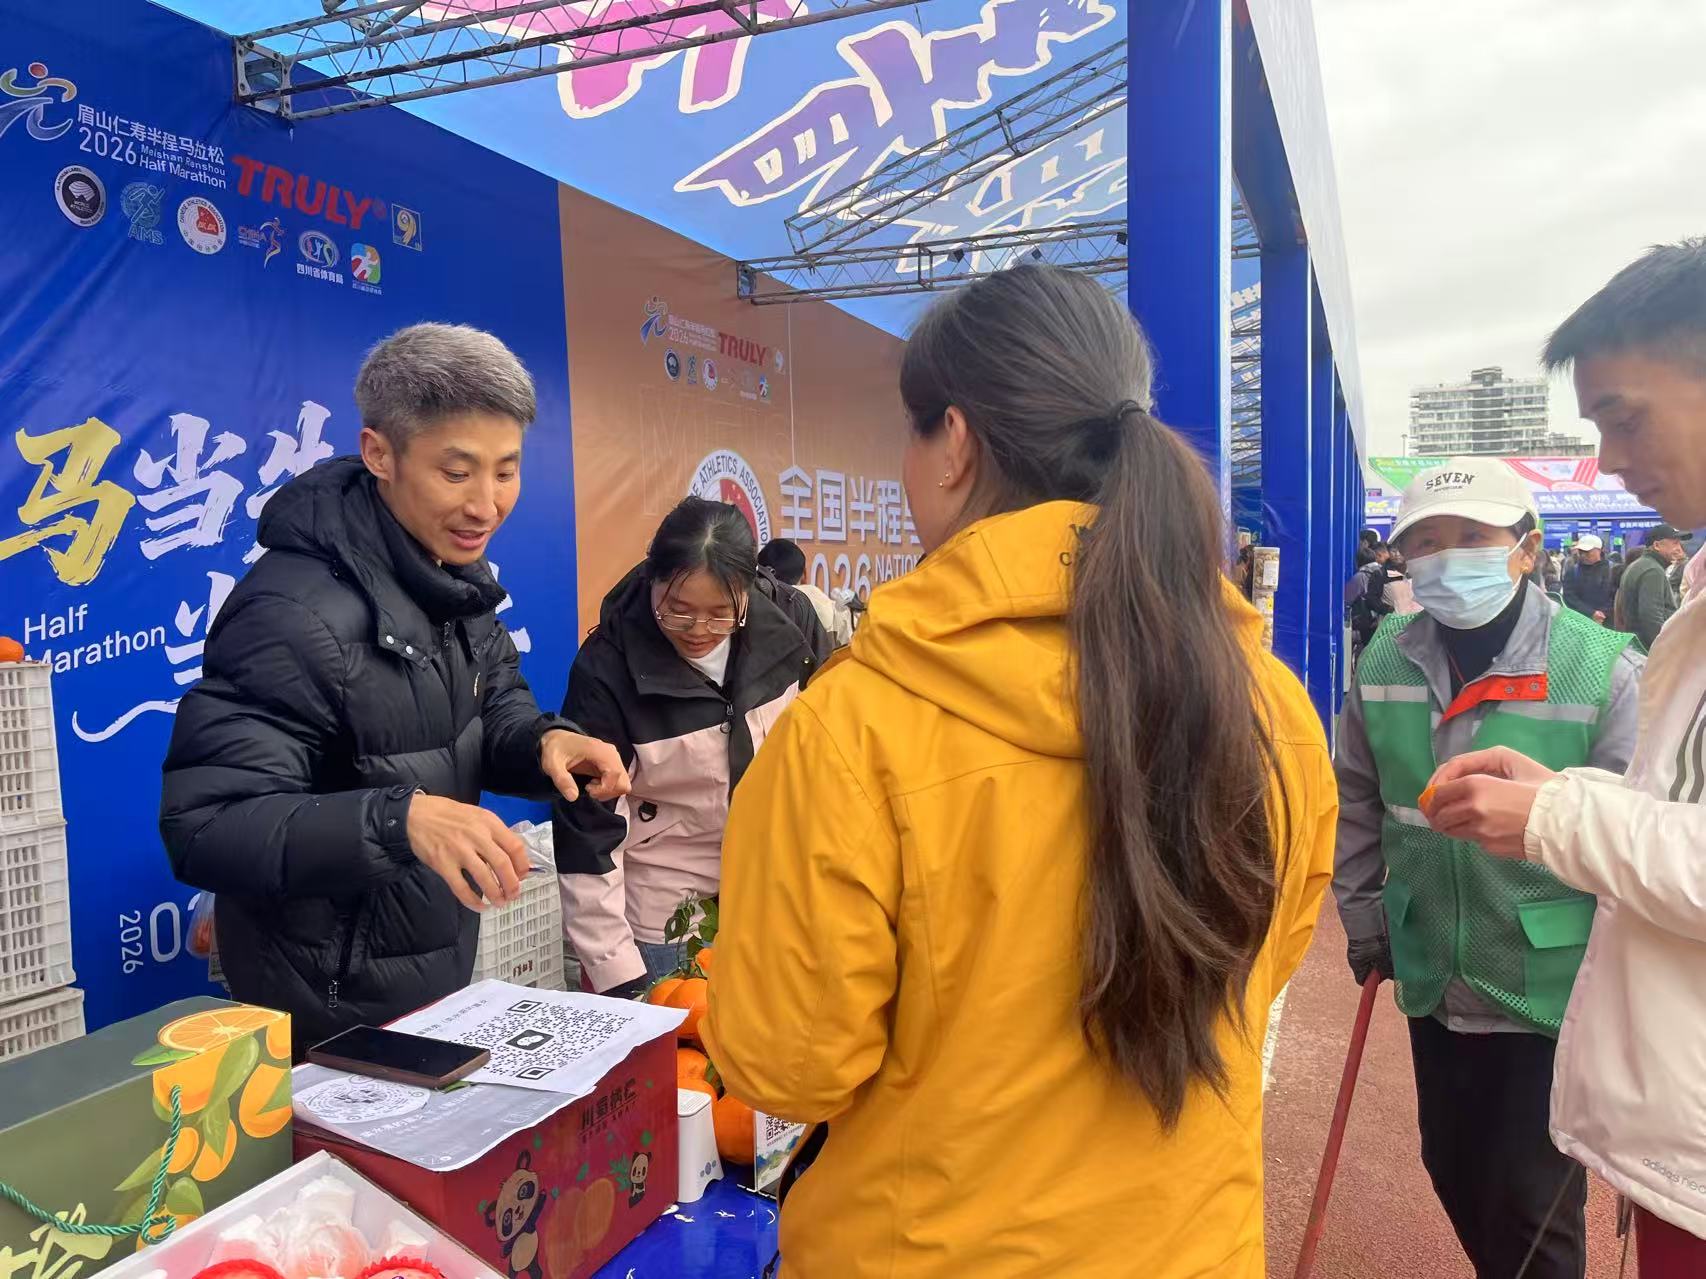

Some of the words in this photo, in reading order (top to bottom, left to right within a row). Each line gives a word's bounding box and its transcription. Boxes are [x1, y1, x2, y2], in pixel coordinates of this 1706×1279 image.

[78, 104, 225, 166] 眉山仁寿半程马拉松
[79, 127, 137, 165] 2026
[141, 144, 184, 162] Meishan
[140, 155, 167, 173] Half
[169, 162, 227, 190] Marathon
[231, 153, 373, 230] TRULY
[128, 224, 164, 245] AIMS
[718, 331, 768, 366] TRULY
[699, 455, 738, 488] ATHLETICS
[739, 467, 769, 546] ASSOCIATIO
[1425, 472, 1475, 491] SEVEN
[24, 603, 88, 645] Half
[119, 910, 144, 974] 2026
